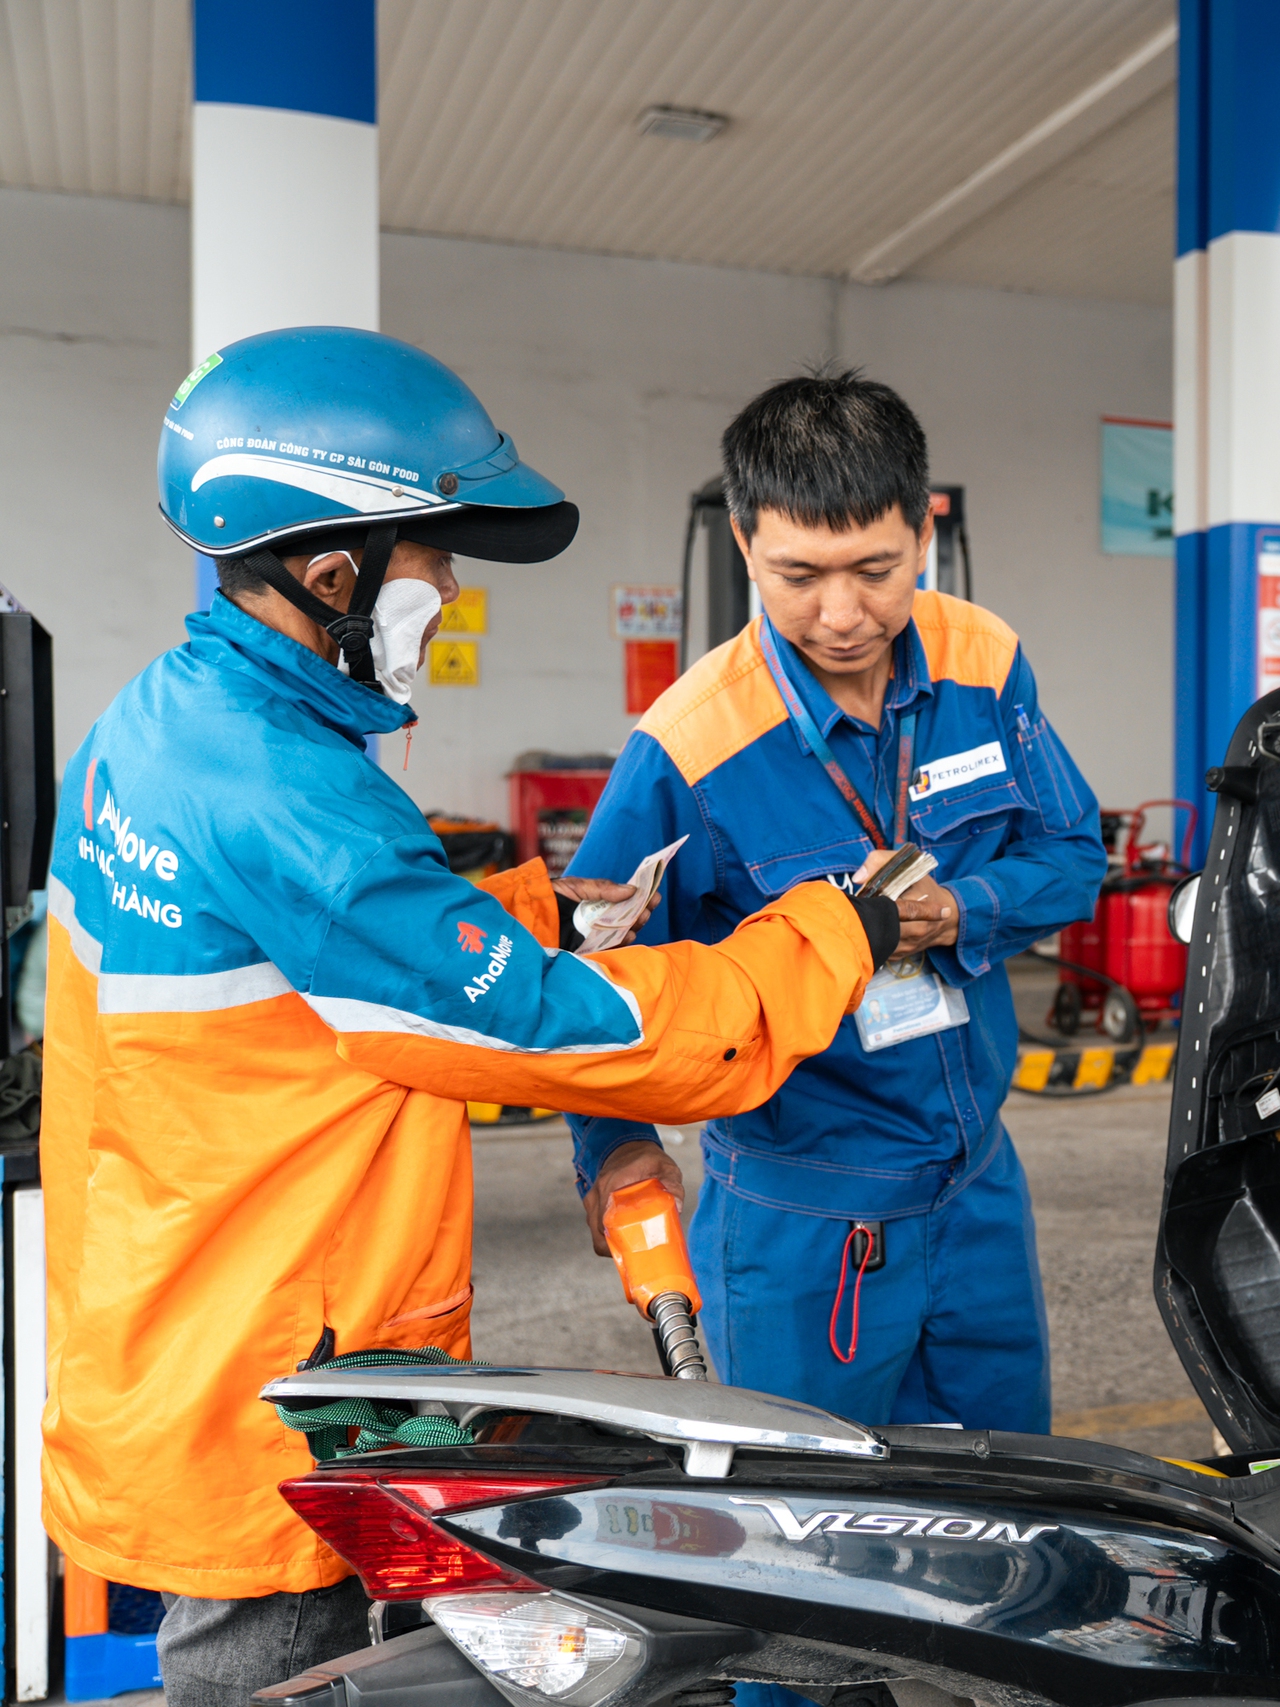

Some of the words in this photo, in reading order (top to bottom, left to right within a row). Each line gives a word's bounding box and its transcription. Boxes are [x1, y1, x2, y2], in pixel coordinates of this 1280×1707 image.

[216, 437, 244, 450] CÔNG
[246, 437, 277, 451] ĐOÀN
[279, 442, 310, 457] CÔNG
[312, 448, 328, 461] TY
[329, 452, 345, 464] CP
[347, 456, 366, 470] SÀI
[368, 460, 391, 475] GÒN
[392, 468, 420, 483] FOOD
[932, 754, 999, 780] PETROLIMEX
[111, 881, 182, 928] HÀNG
[463, 934, 514, 1003] AhaMove
[728, 1495, 1060, 1546] VISION
